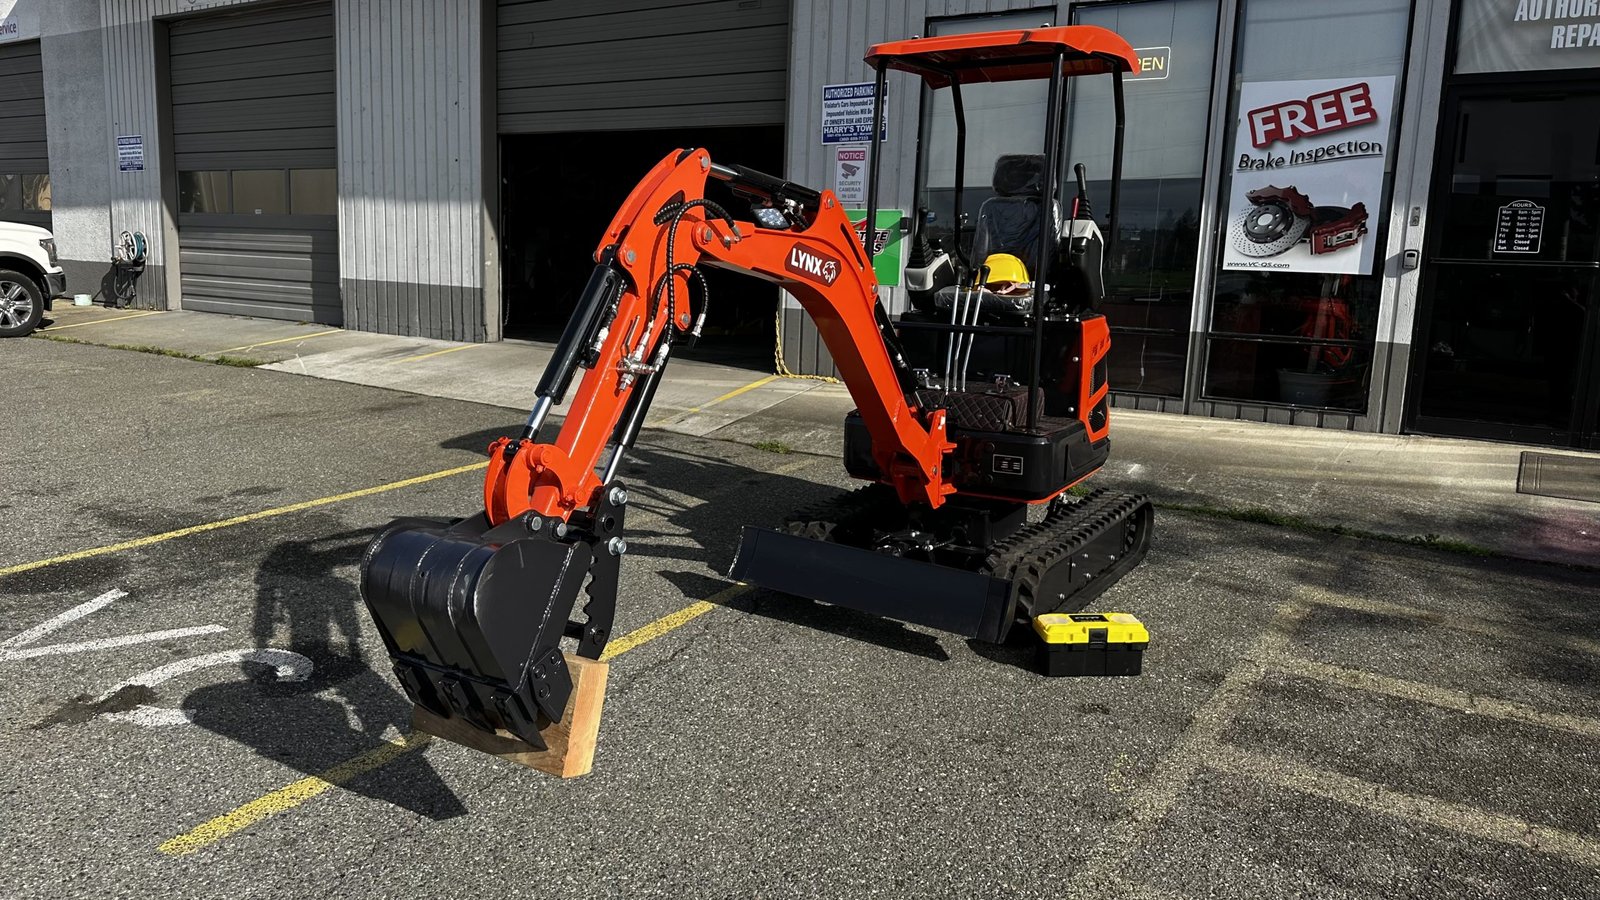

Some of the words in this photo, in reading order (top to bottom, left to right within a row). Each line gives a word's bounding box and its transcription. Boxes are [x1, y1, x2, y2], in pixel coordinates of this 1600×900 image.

[824, 87, 854, 99] AUTHORIZED
[853, 85, 874, 97] PARKING
[1251, 87, 1371, 145] FREE
[823, 125, 855, 134] HARRY'S
[838, 152, 865, 160] NOTICE
[1238, 150, 1285, 171] Brake
[1289, 140, 1383, 166] Inspection
[791, 248, 823, 276] LYNX
